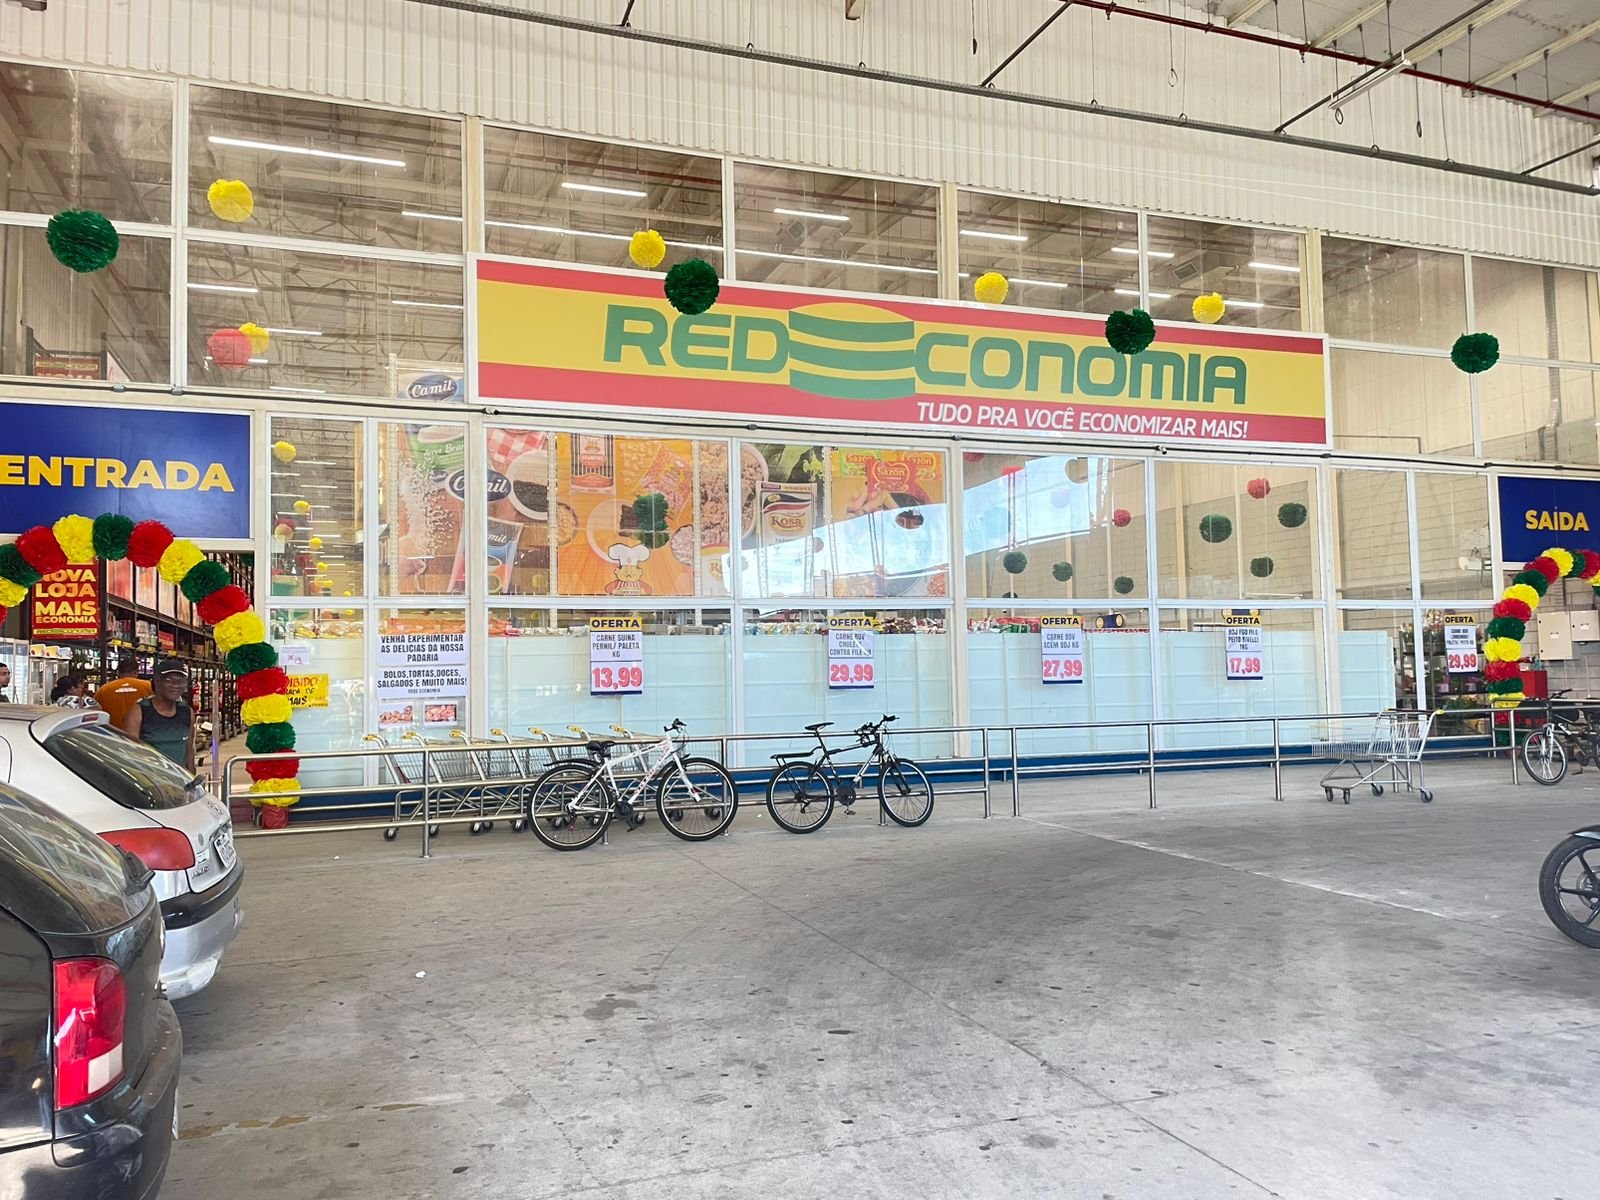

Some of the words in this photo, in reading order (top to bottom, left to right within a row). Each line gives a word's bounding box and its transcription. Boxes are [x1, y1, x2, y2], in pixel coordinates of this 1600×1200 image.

[411, 379, 456, 398] Camil
[917, 402, 973, 424] TUDO
[977, 405, 1019, 427] PRA
[1024, 406, 1074, 430] VOCÊ
[1079, 411, 1198, 437] ECONOMIZAR
[1201, 418, 1248, 440] MAIS!
[0, 454, 235, 493] ENTRADA
[35, 583, 97, 598] LOJA
[35, 600, 97, 616] MAIS
[35, 616, 97, 624] ECONOMIA
[591, 619, 640, 628] OFERTA
[830, 618, 872, 627] OFERTA
[1042, 617, 1080, 625] OFERTA
[1226, 617, 1260, 625] OFERTA
[381, 635, 406, 643] VENHA
[407, 634, 464, 643] EXPERIMENTAR
[380, 645, 391, 653] AS
[393, 644, 426, 653] DELICIAS
[428, 644, 438, 652] DA
[440, 643, 464, 652] NOSSA
[407, 653, 439, 662] PADARIA
[1448, 653, 1477, 670] 29,99
[1043, 659, 1083, 679] 27,99
[1230, 657, 1261, 675] 17,99
[592, 666, 643, 690] 13,99
[830, 663, 874, 684] 29,99
[289, 677, 319, 687] IBIDO
[377, 679, 414, 688] SALGADOS
[422, 679, 445, 687] MUITO
